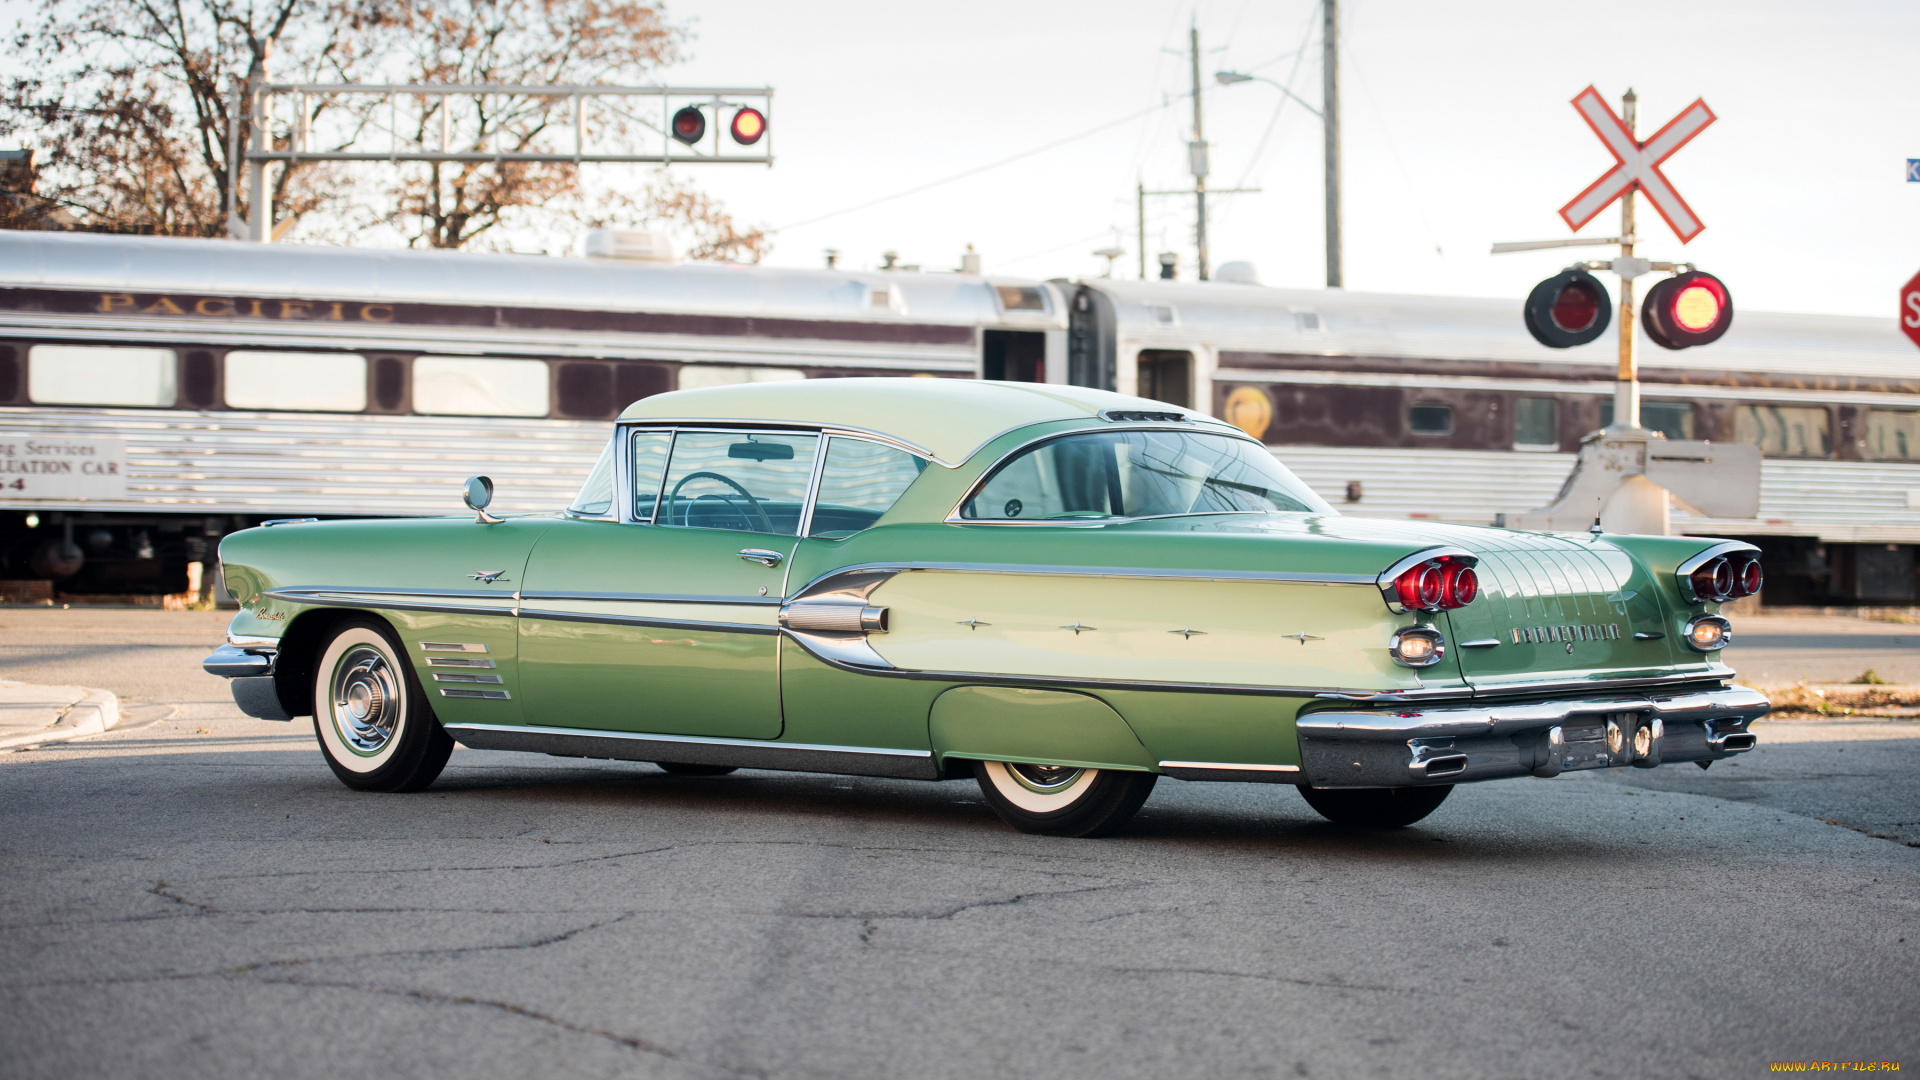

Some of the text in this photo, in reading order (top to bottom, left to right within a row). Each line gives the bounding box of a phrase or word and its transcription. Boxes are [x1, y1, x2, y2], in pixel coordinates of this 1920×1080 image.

[100, 294, 396, 322] PACIFIC
[1905, 291, 1920, 328] S
[25, 440, 97, 456] Services
[82, 461, 119, 475] CAR
[0, 478, 25, 491] 4
